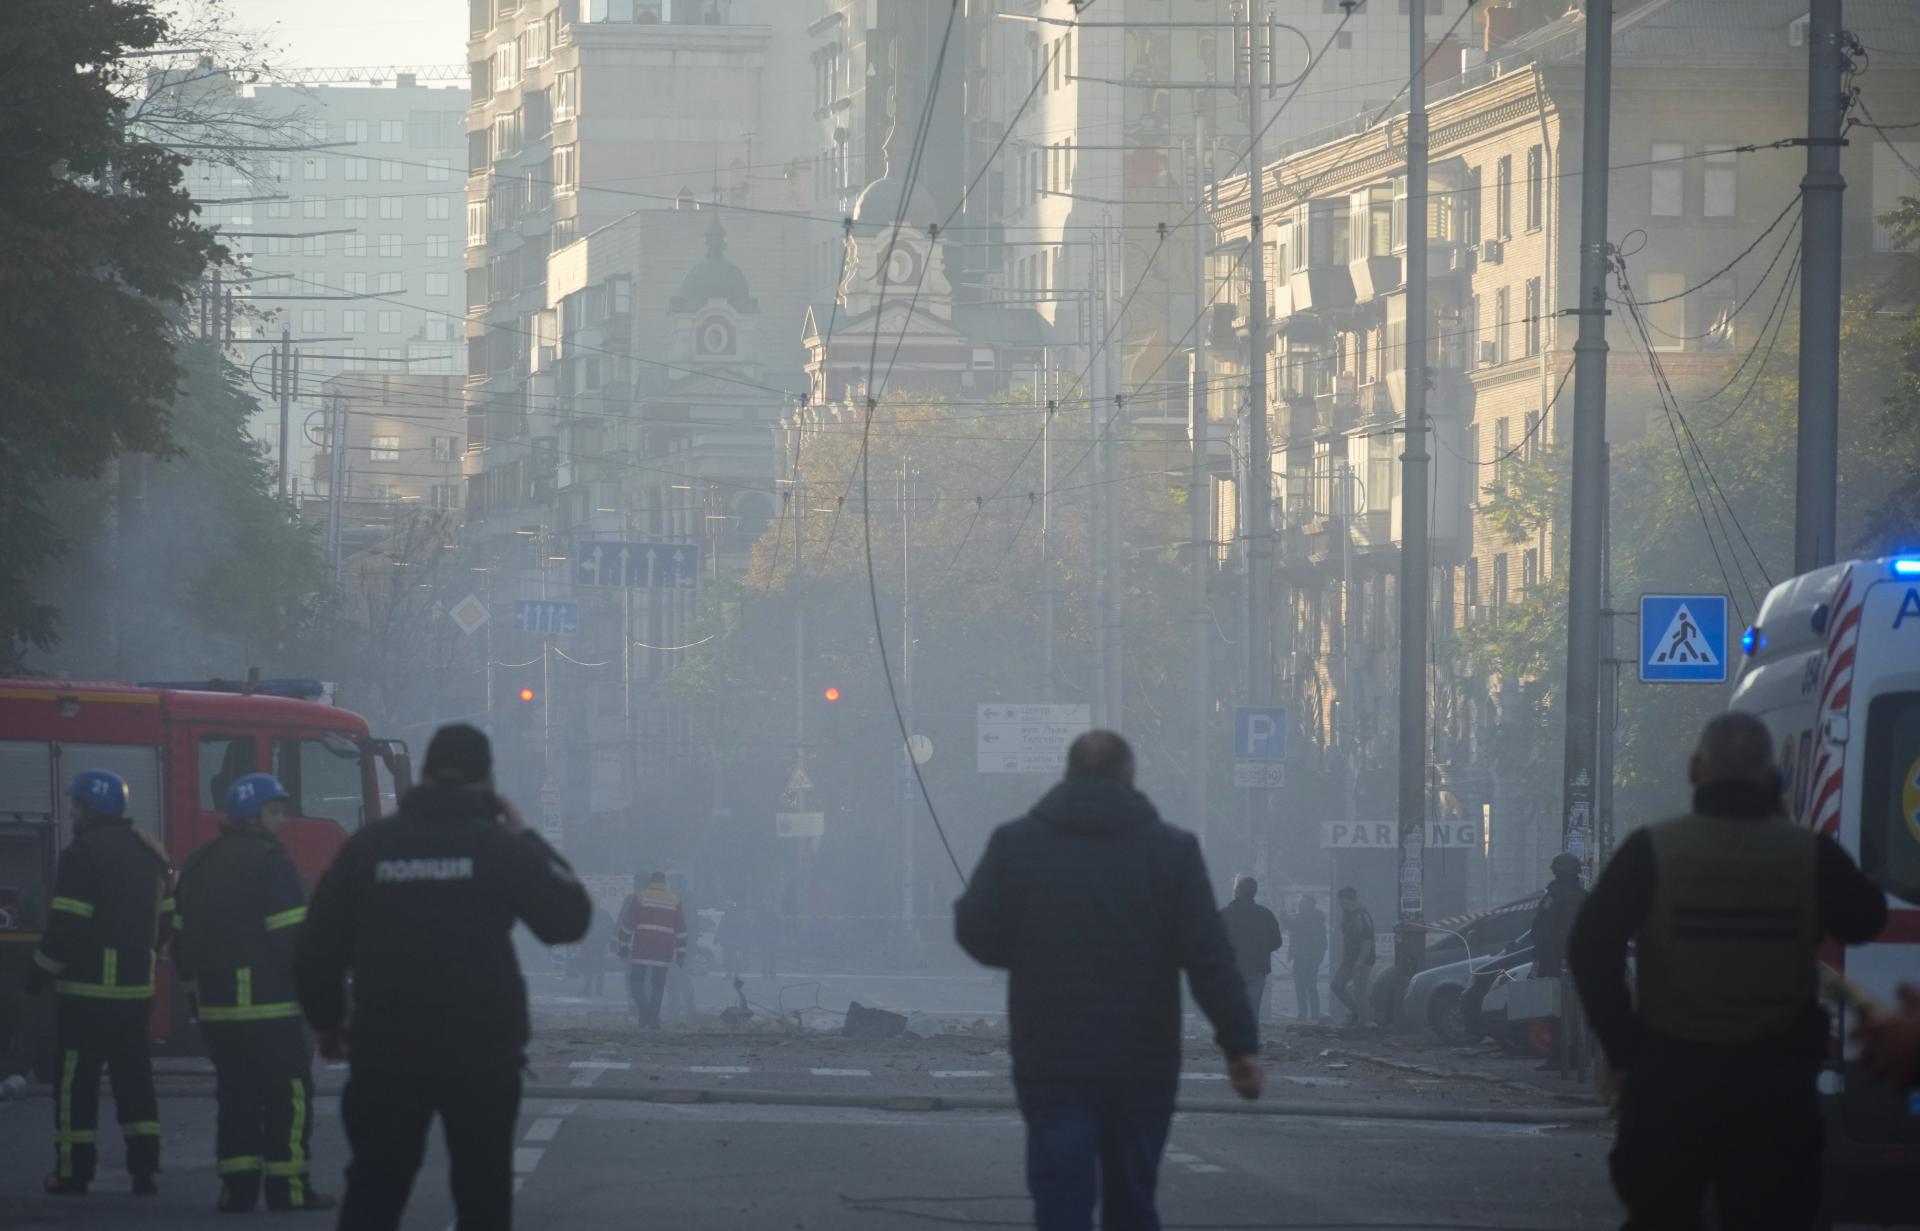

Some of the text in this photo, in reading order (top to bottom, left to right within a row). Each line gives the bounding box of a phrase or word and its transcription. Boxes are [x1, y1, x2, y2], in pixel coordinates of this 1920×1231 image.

[1248, 713, 1274, 753] P
[91, 780, 108, 795] 21
[238, 784, 254, 800] 21
[1332, 824, 1475, 844] PARNG
